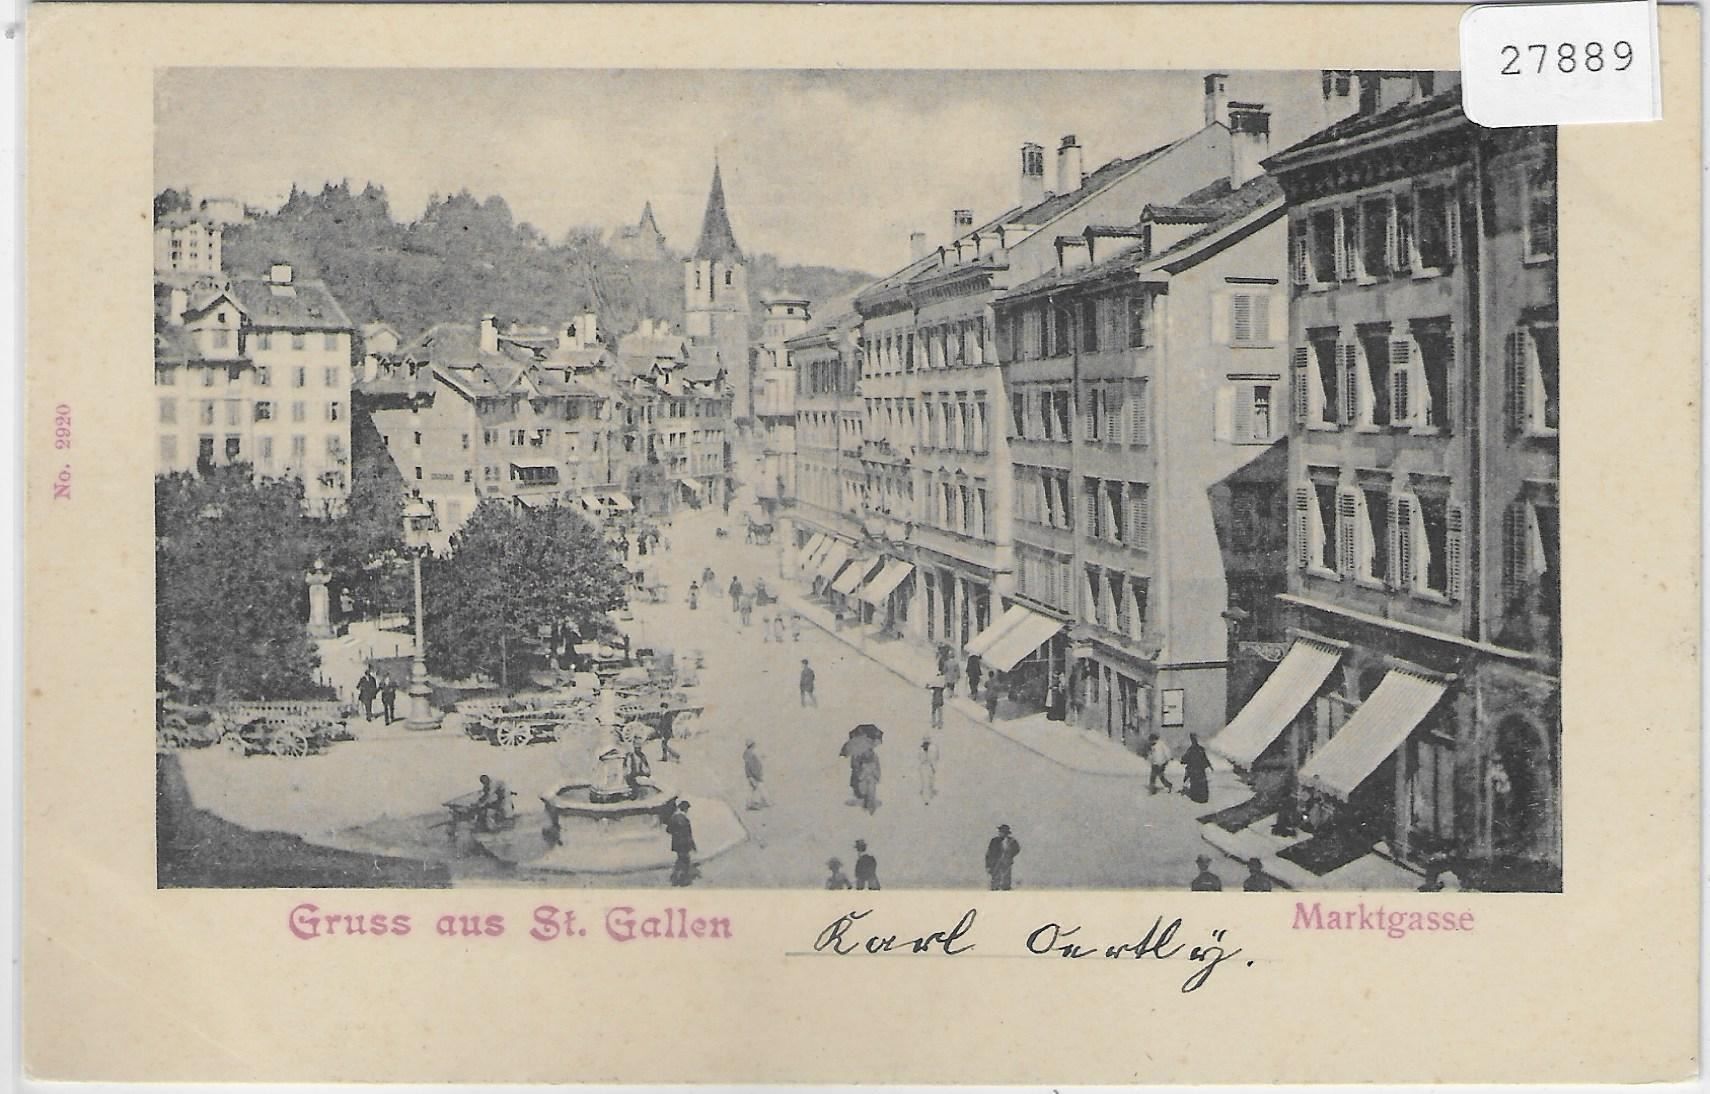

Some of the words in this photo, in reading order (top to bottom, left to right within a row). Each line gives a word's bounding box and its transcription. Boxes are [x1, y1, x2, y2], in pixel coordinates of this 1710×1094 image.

[1500, 40, 1633, 75] 27889
[54, 403, 72, 450] 2920
[53, 463, 72, 501] No.
[288, 902, 412, 941] Gruss
[436, 912, 503, 937] aus
[529, 904, 587, 942] St.
[605, 906, 732, 943] Gallen
[1293, 902, 1475, 939] Marktgasse
